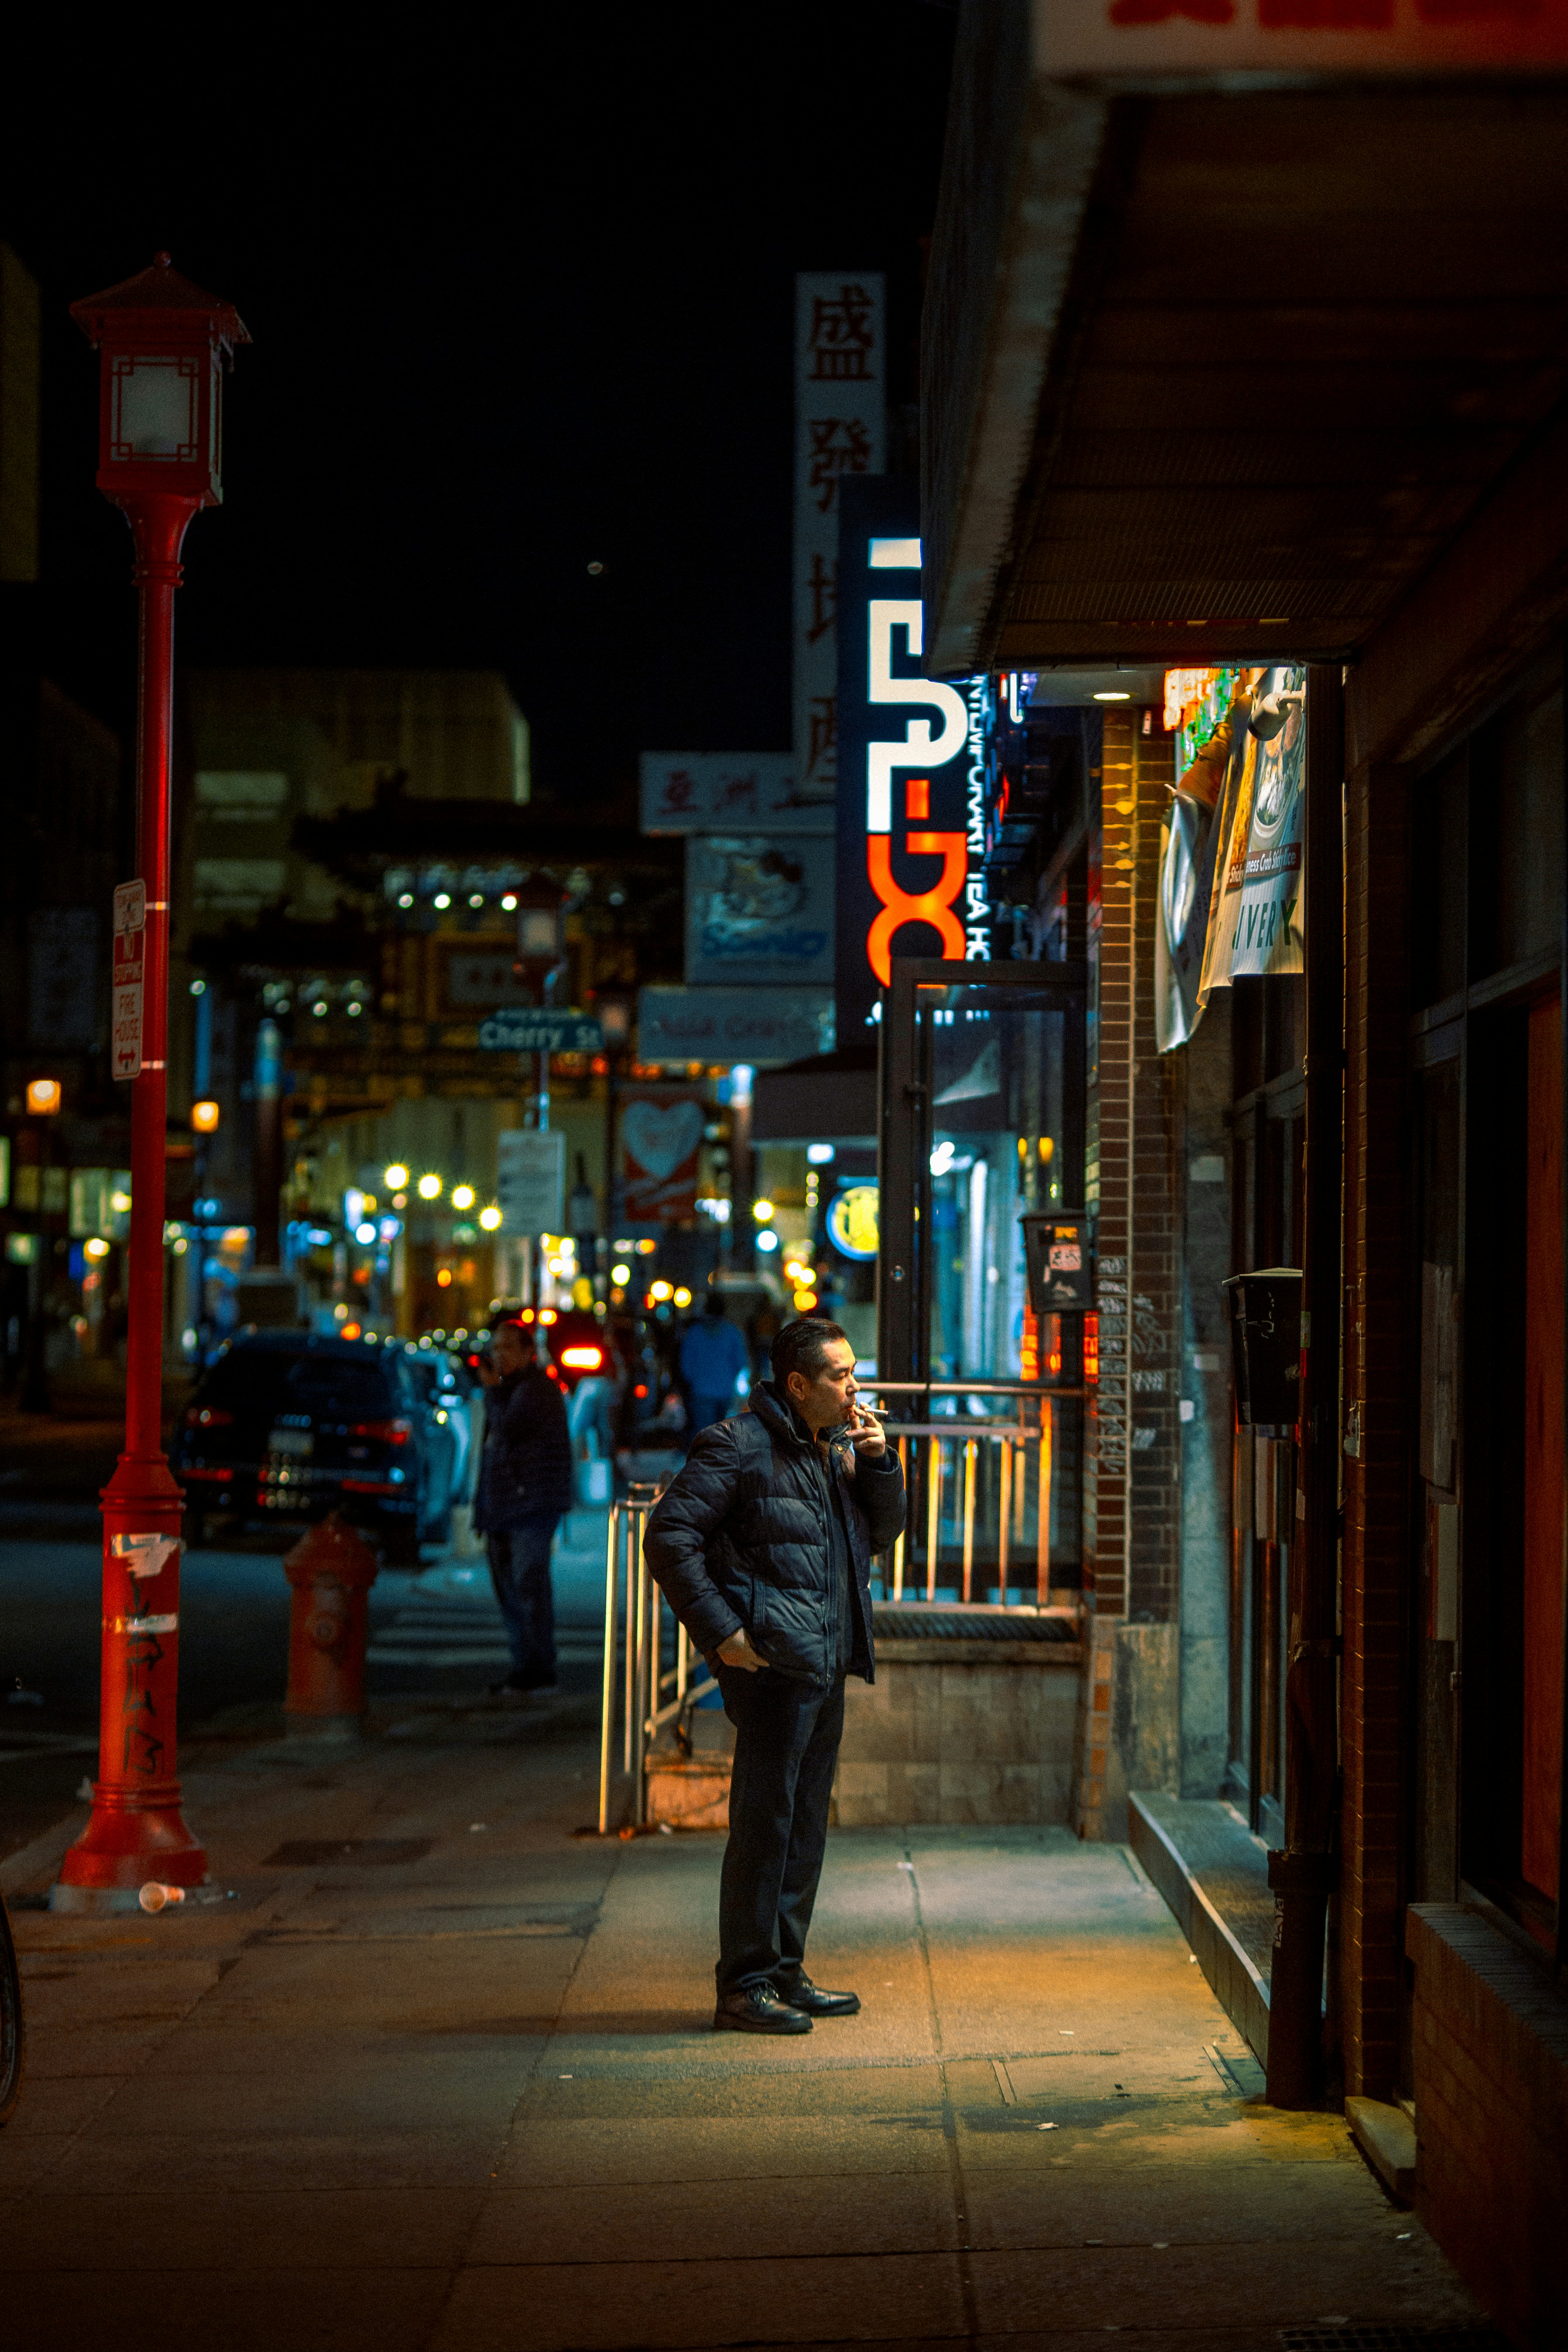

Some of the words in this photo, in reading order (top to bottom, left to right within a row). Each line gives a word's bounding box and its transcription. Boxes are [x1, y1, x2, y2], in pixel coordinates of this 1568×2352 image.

[868, 538, 968, 988] EA-DO
[1259, 850, 1272, 872] Crab
[1272, 848, 1284, 873] Sticky
[1283, 846, 1297, 866] Rice
[480, 1020, 563, 1050] Cherry
[576, 1025, 600, 1048] St
